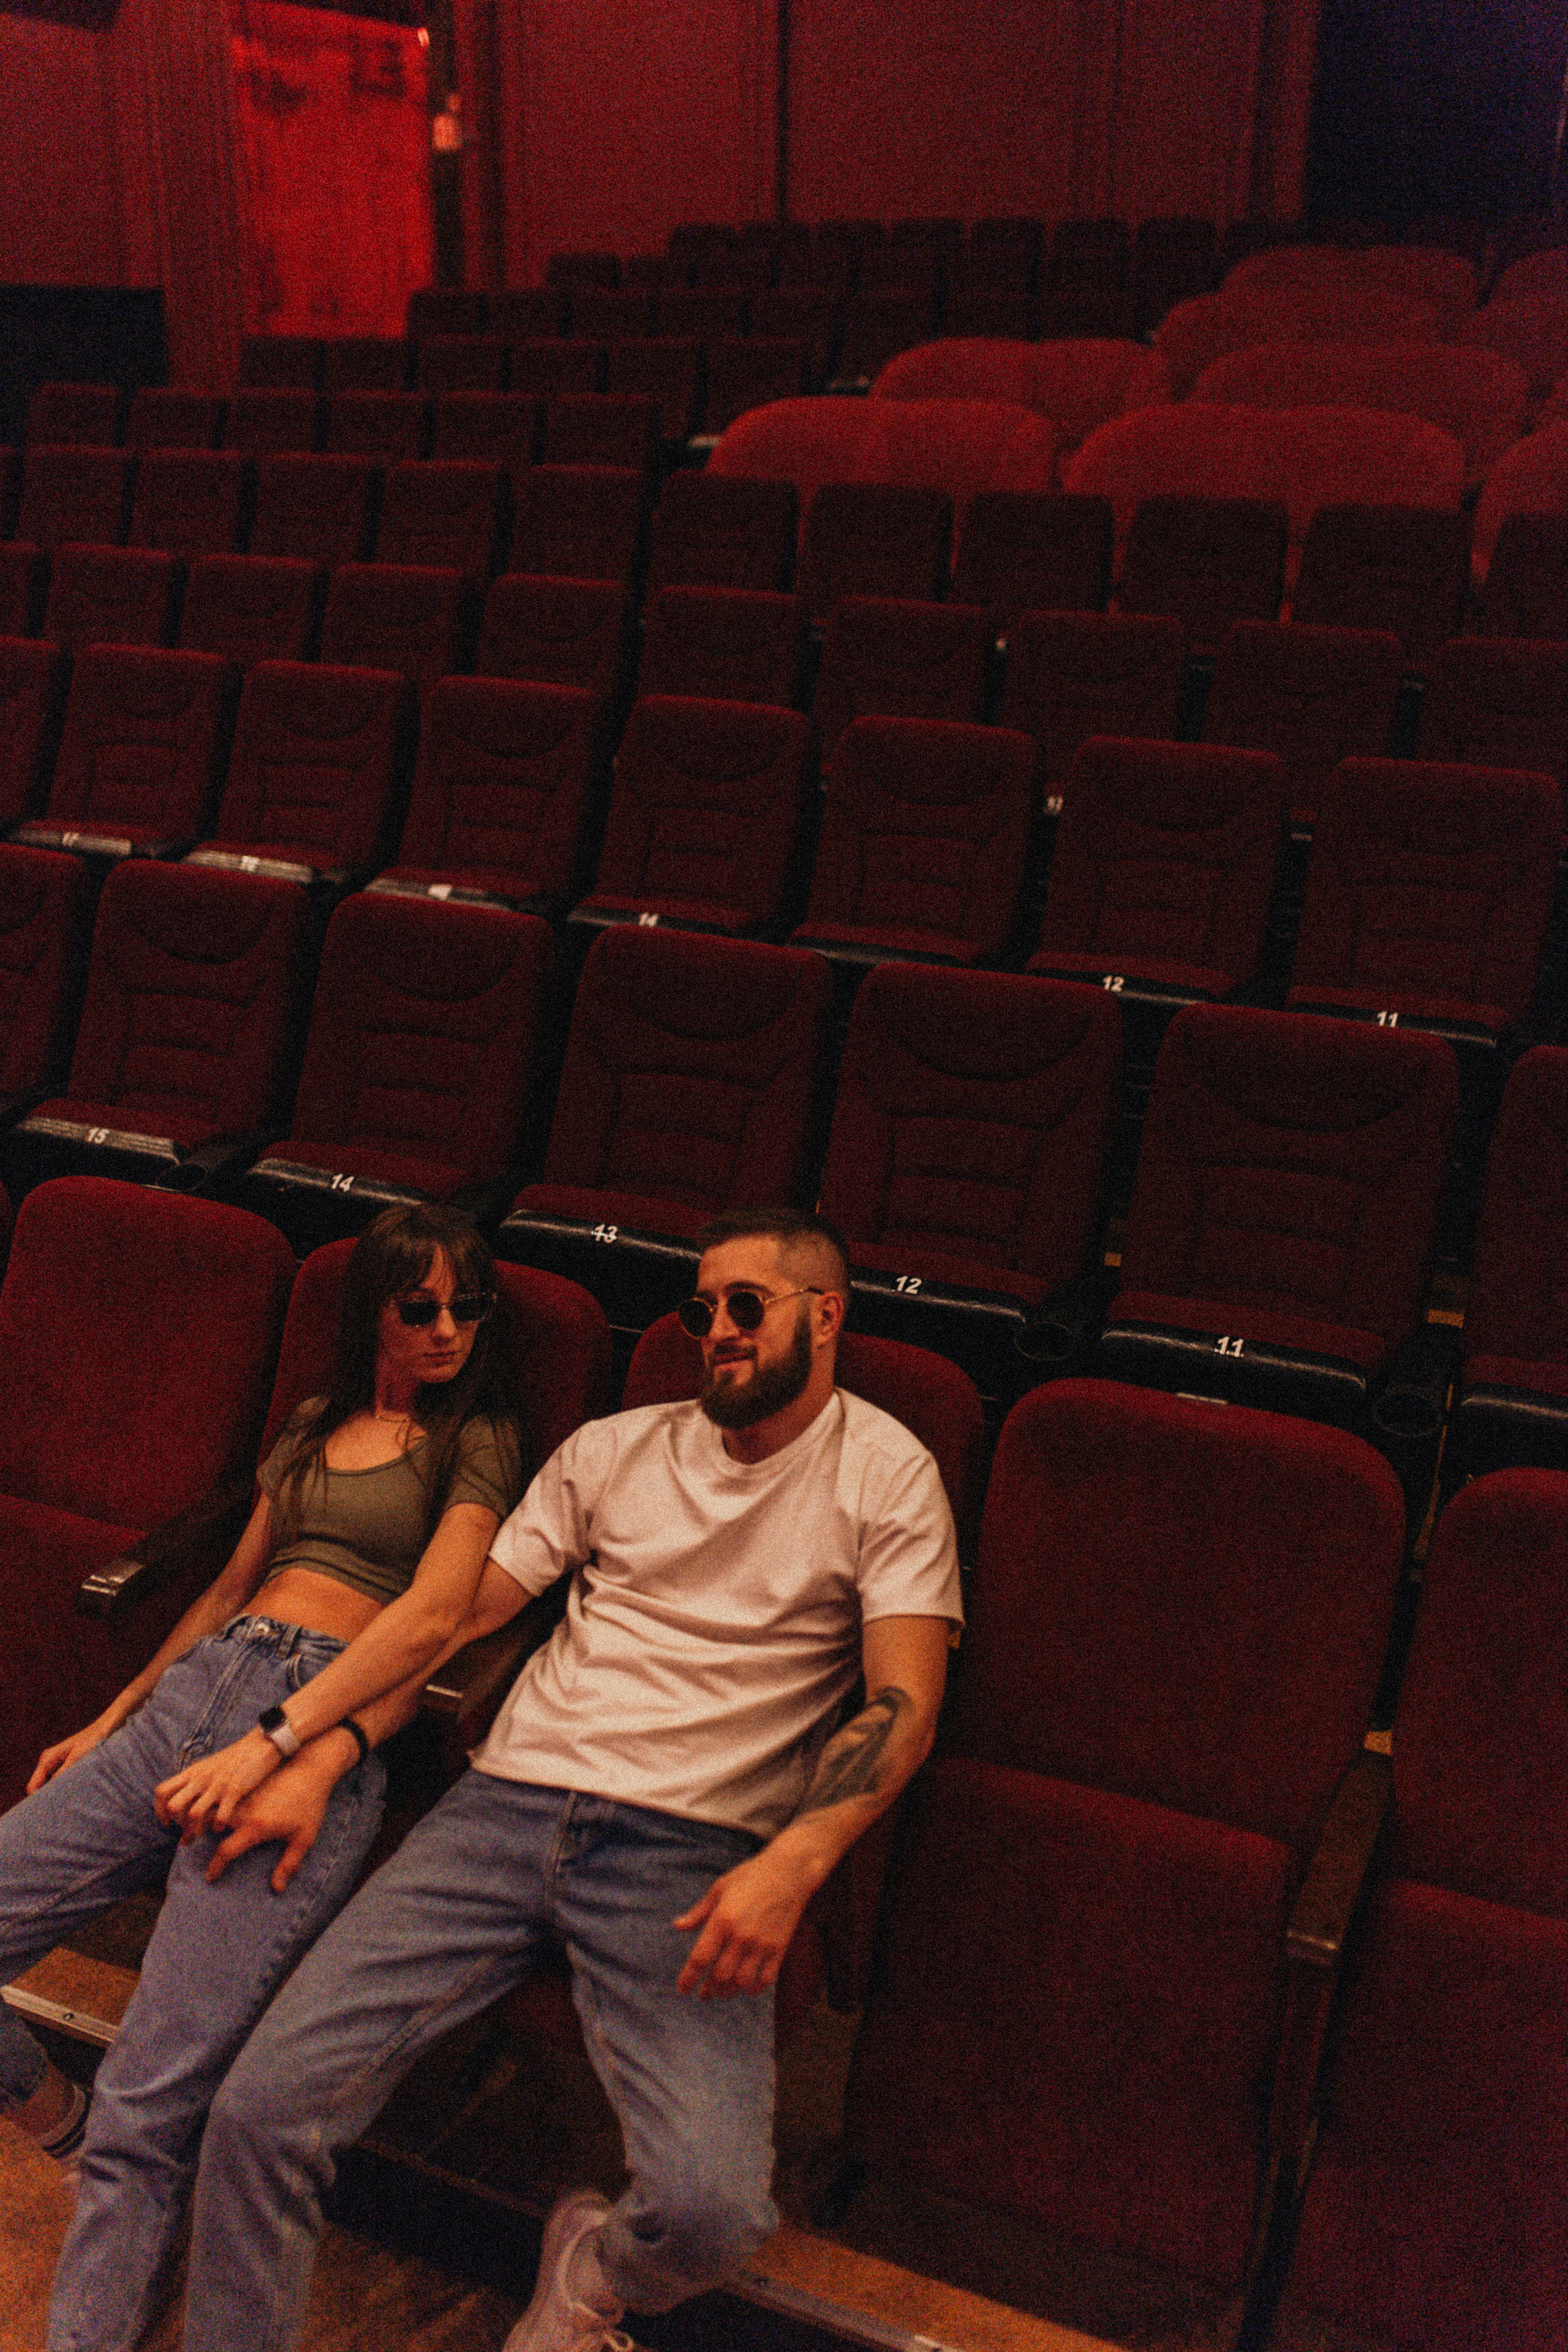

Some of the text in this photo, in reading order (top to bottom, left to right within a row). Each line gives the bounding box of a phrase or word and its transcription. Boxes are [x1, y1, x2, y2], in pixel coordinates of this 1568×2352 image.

[1102, 974, 1125, 992] 12
[1376, 1010, 1399, 1028] 11
[87, 1126, 110, 1144] 15
[331, 1172, 355, 1192] 14
[593, 1223, 618, 1244] 13
[895, 1275, 922, 1295] 12
[1216, 1336, 1244, 1358] 11
